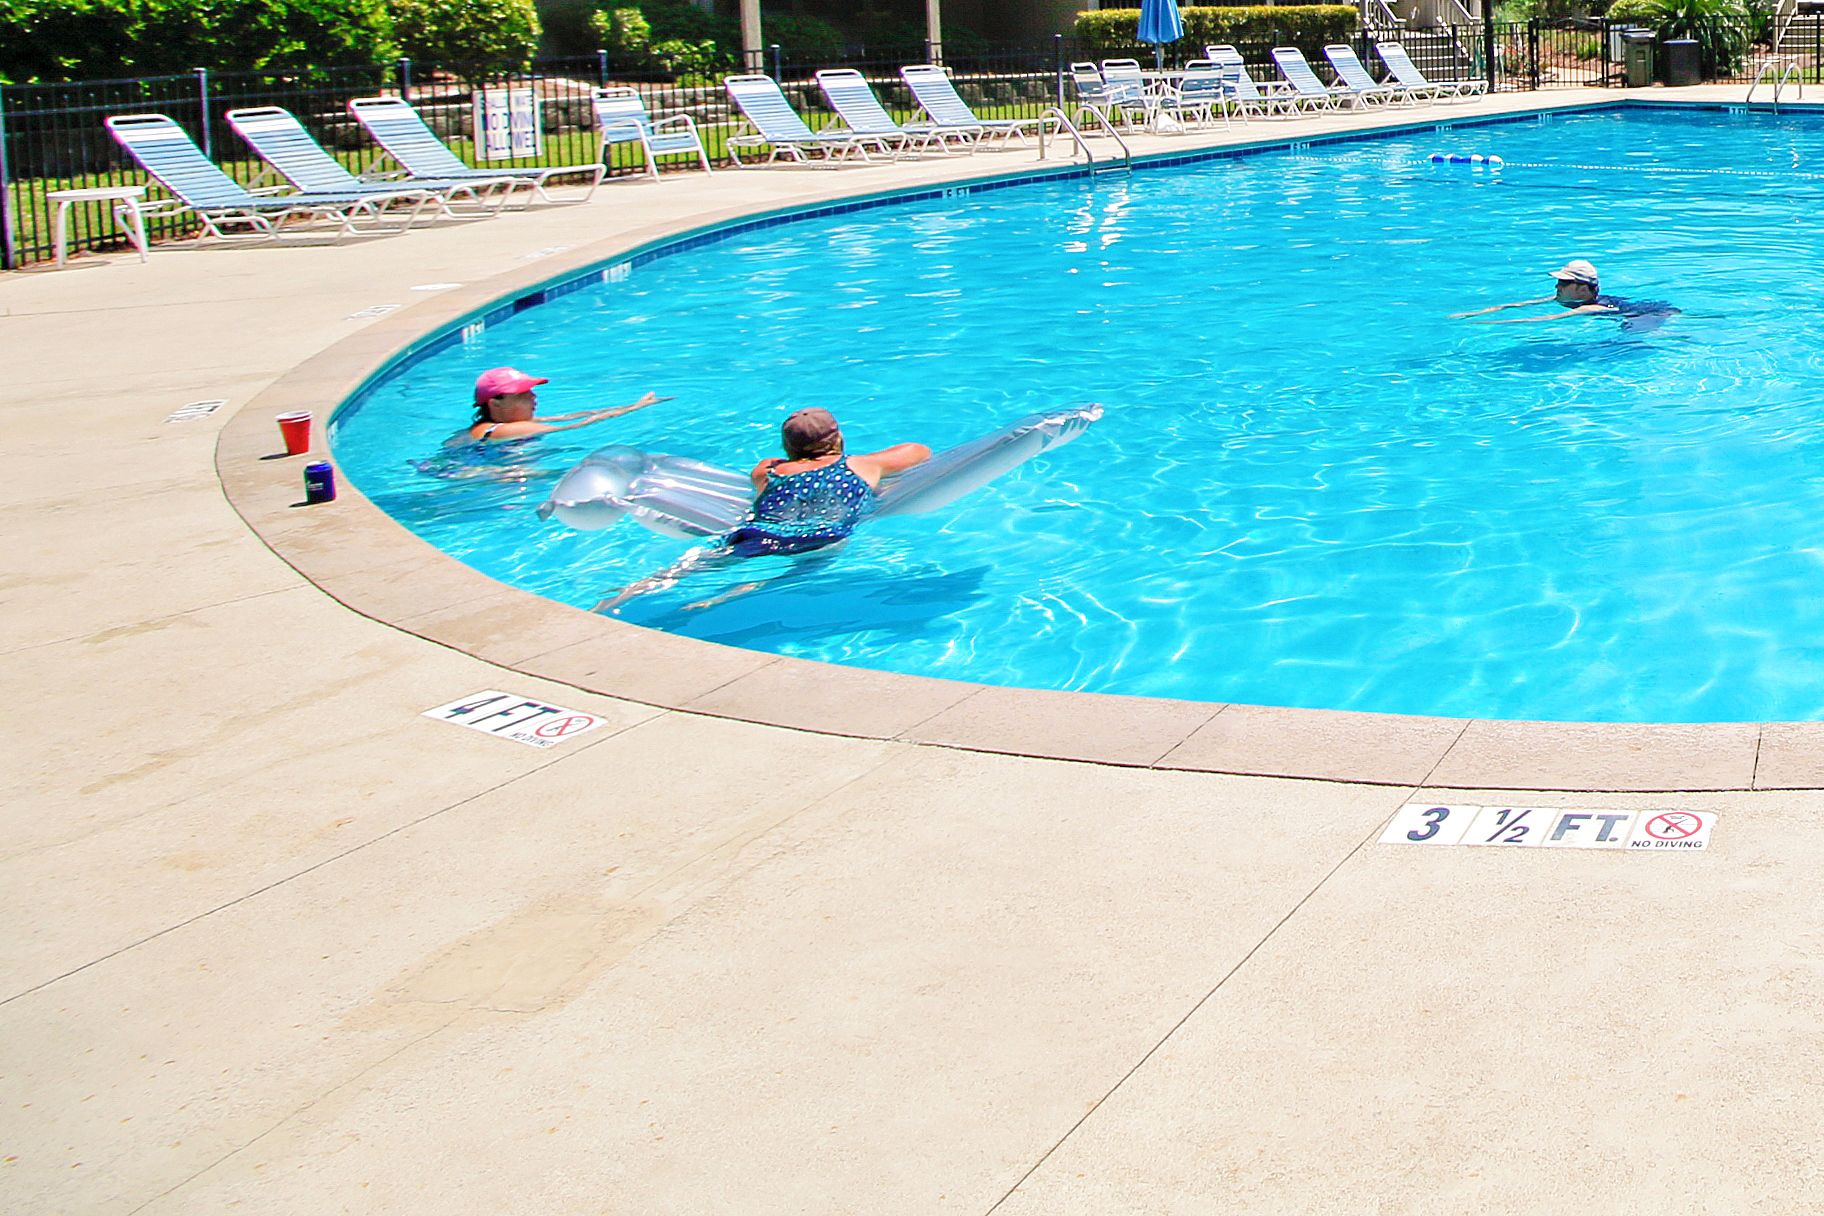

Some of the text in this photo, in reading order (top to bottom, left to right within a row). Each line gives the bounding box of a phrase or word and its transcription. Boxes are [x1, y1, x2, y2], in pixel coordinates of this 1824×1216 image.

[445, 695, 563, 733] 4 FT
[1406, 807, 1451, 842] 3
[1550, 813, 1629, 843] FT.
[1631, 840, 1704, 849] NO DIVING
